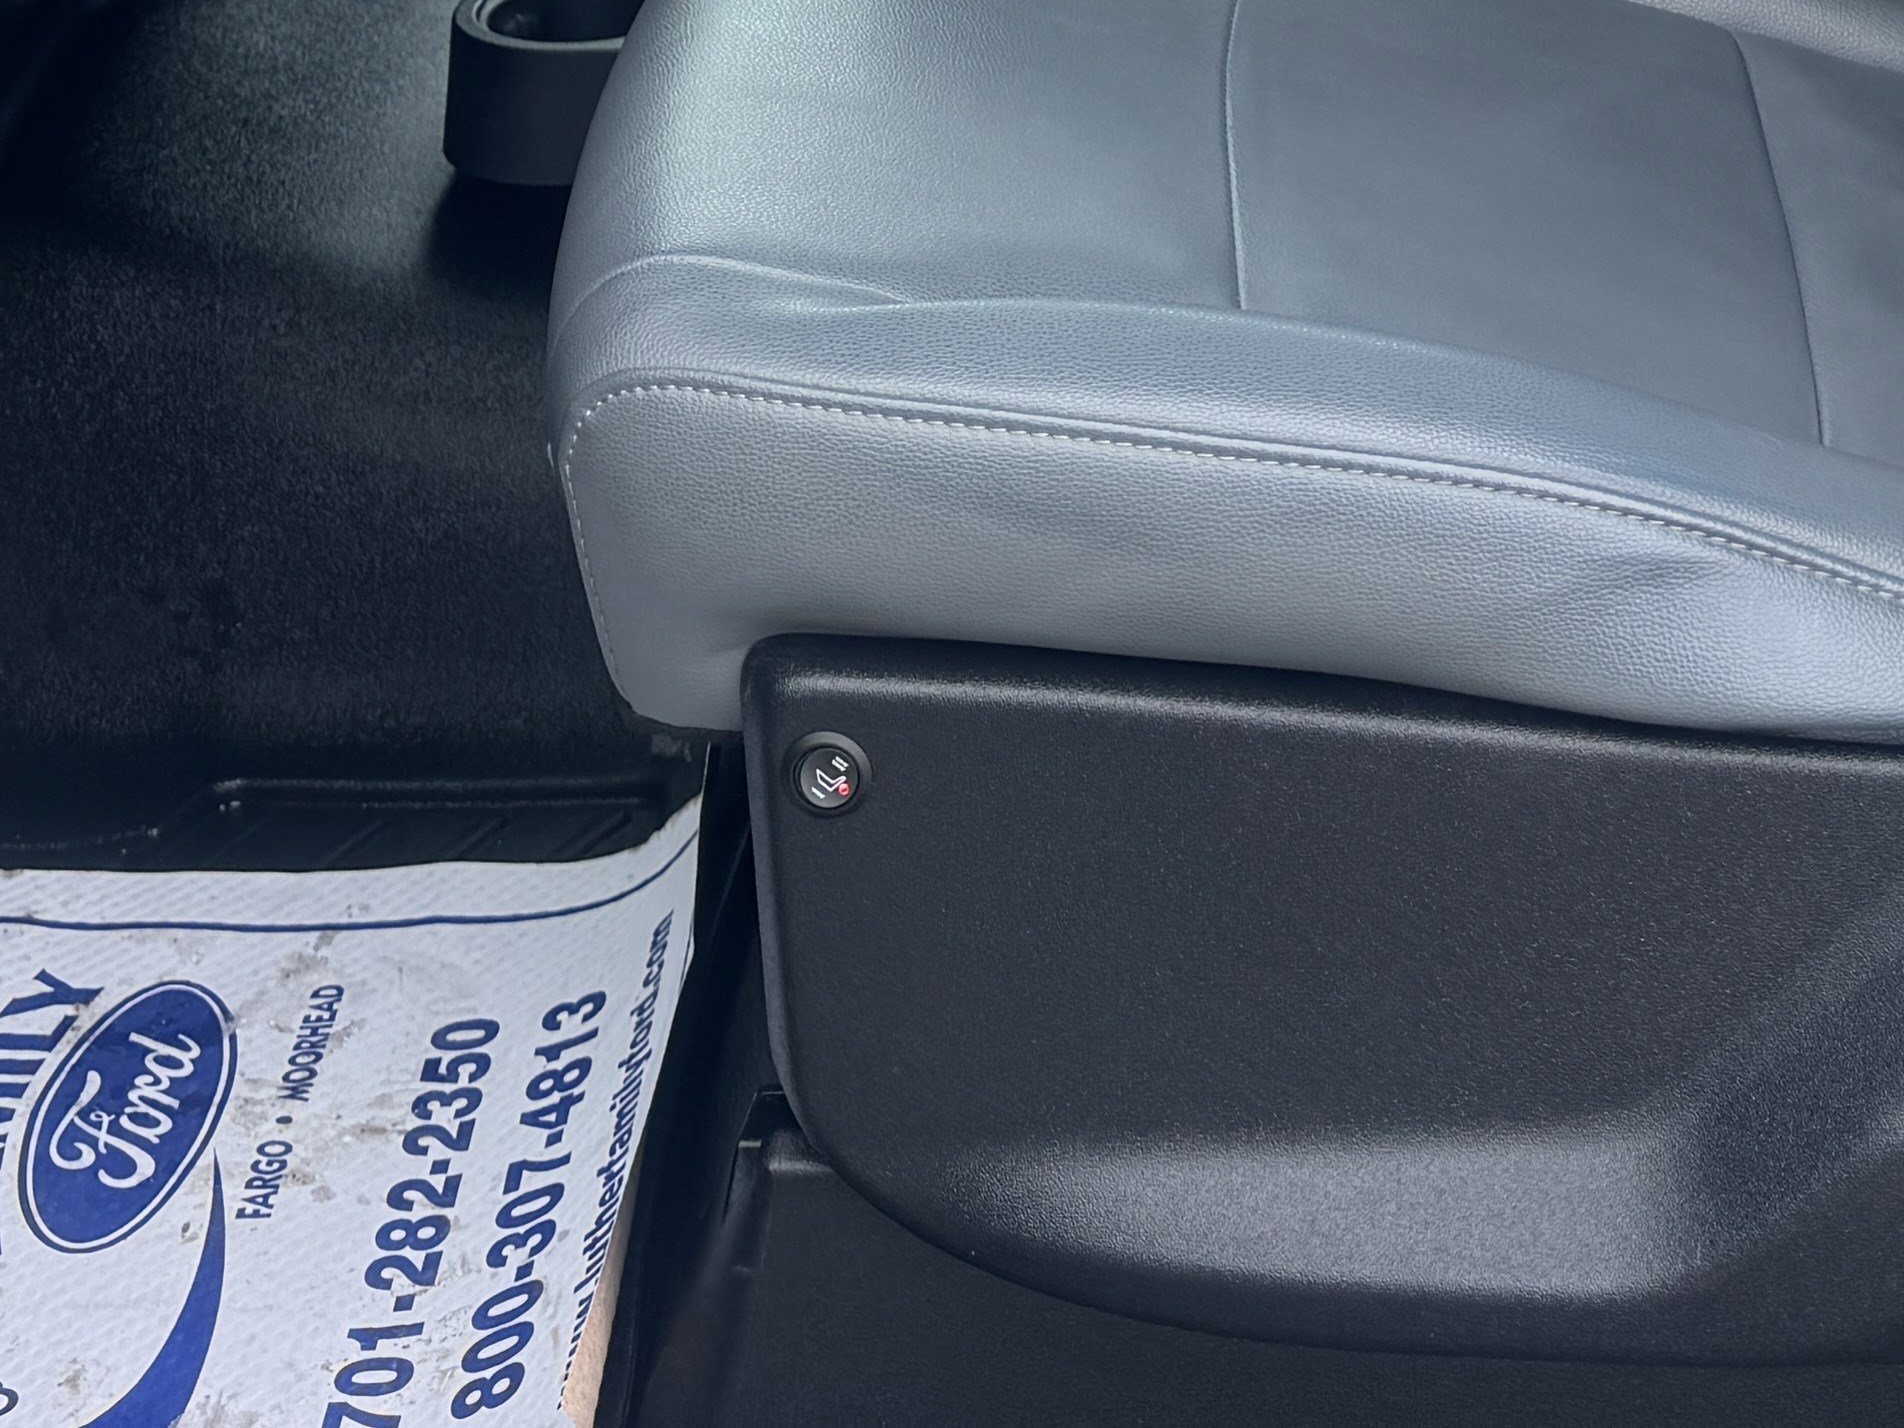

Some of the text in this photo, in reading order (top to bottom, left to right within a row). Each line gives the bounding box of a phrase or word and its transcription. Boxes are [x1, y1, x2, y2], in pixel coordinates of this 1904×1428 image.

[50, 1032, 203, 1190] Ford
[235, 983, 345, 1221] FARGO MOORHEAD
[321, 1017, 502, 1428] 701-282-2350
[451, 990, 608, 1421] 800-307-4813
